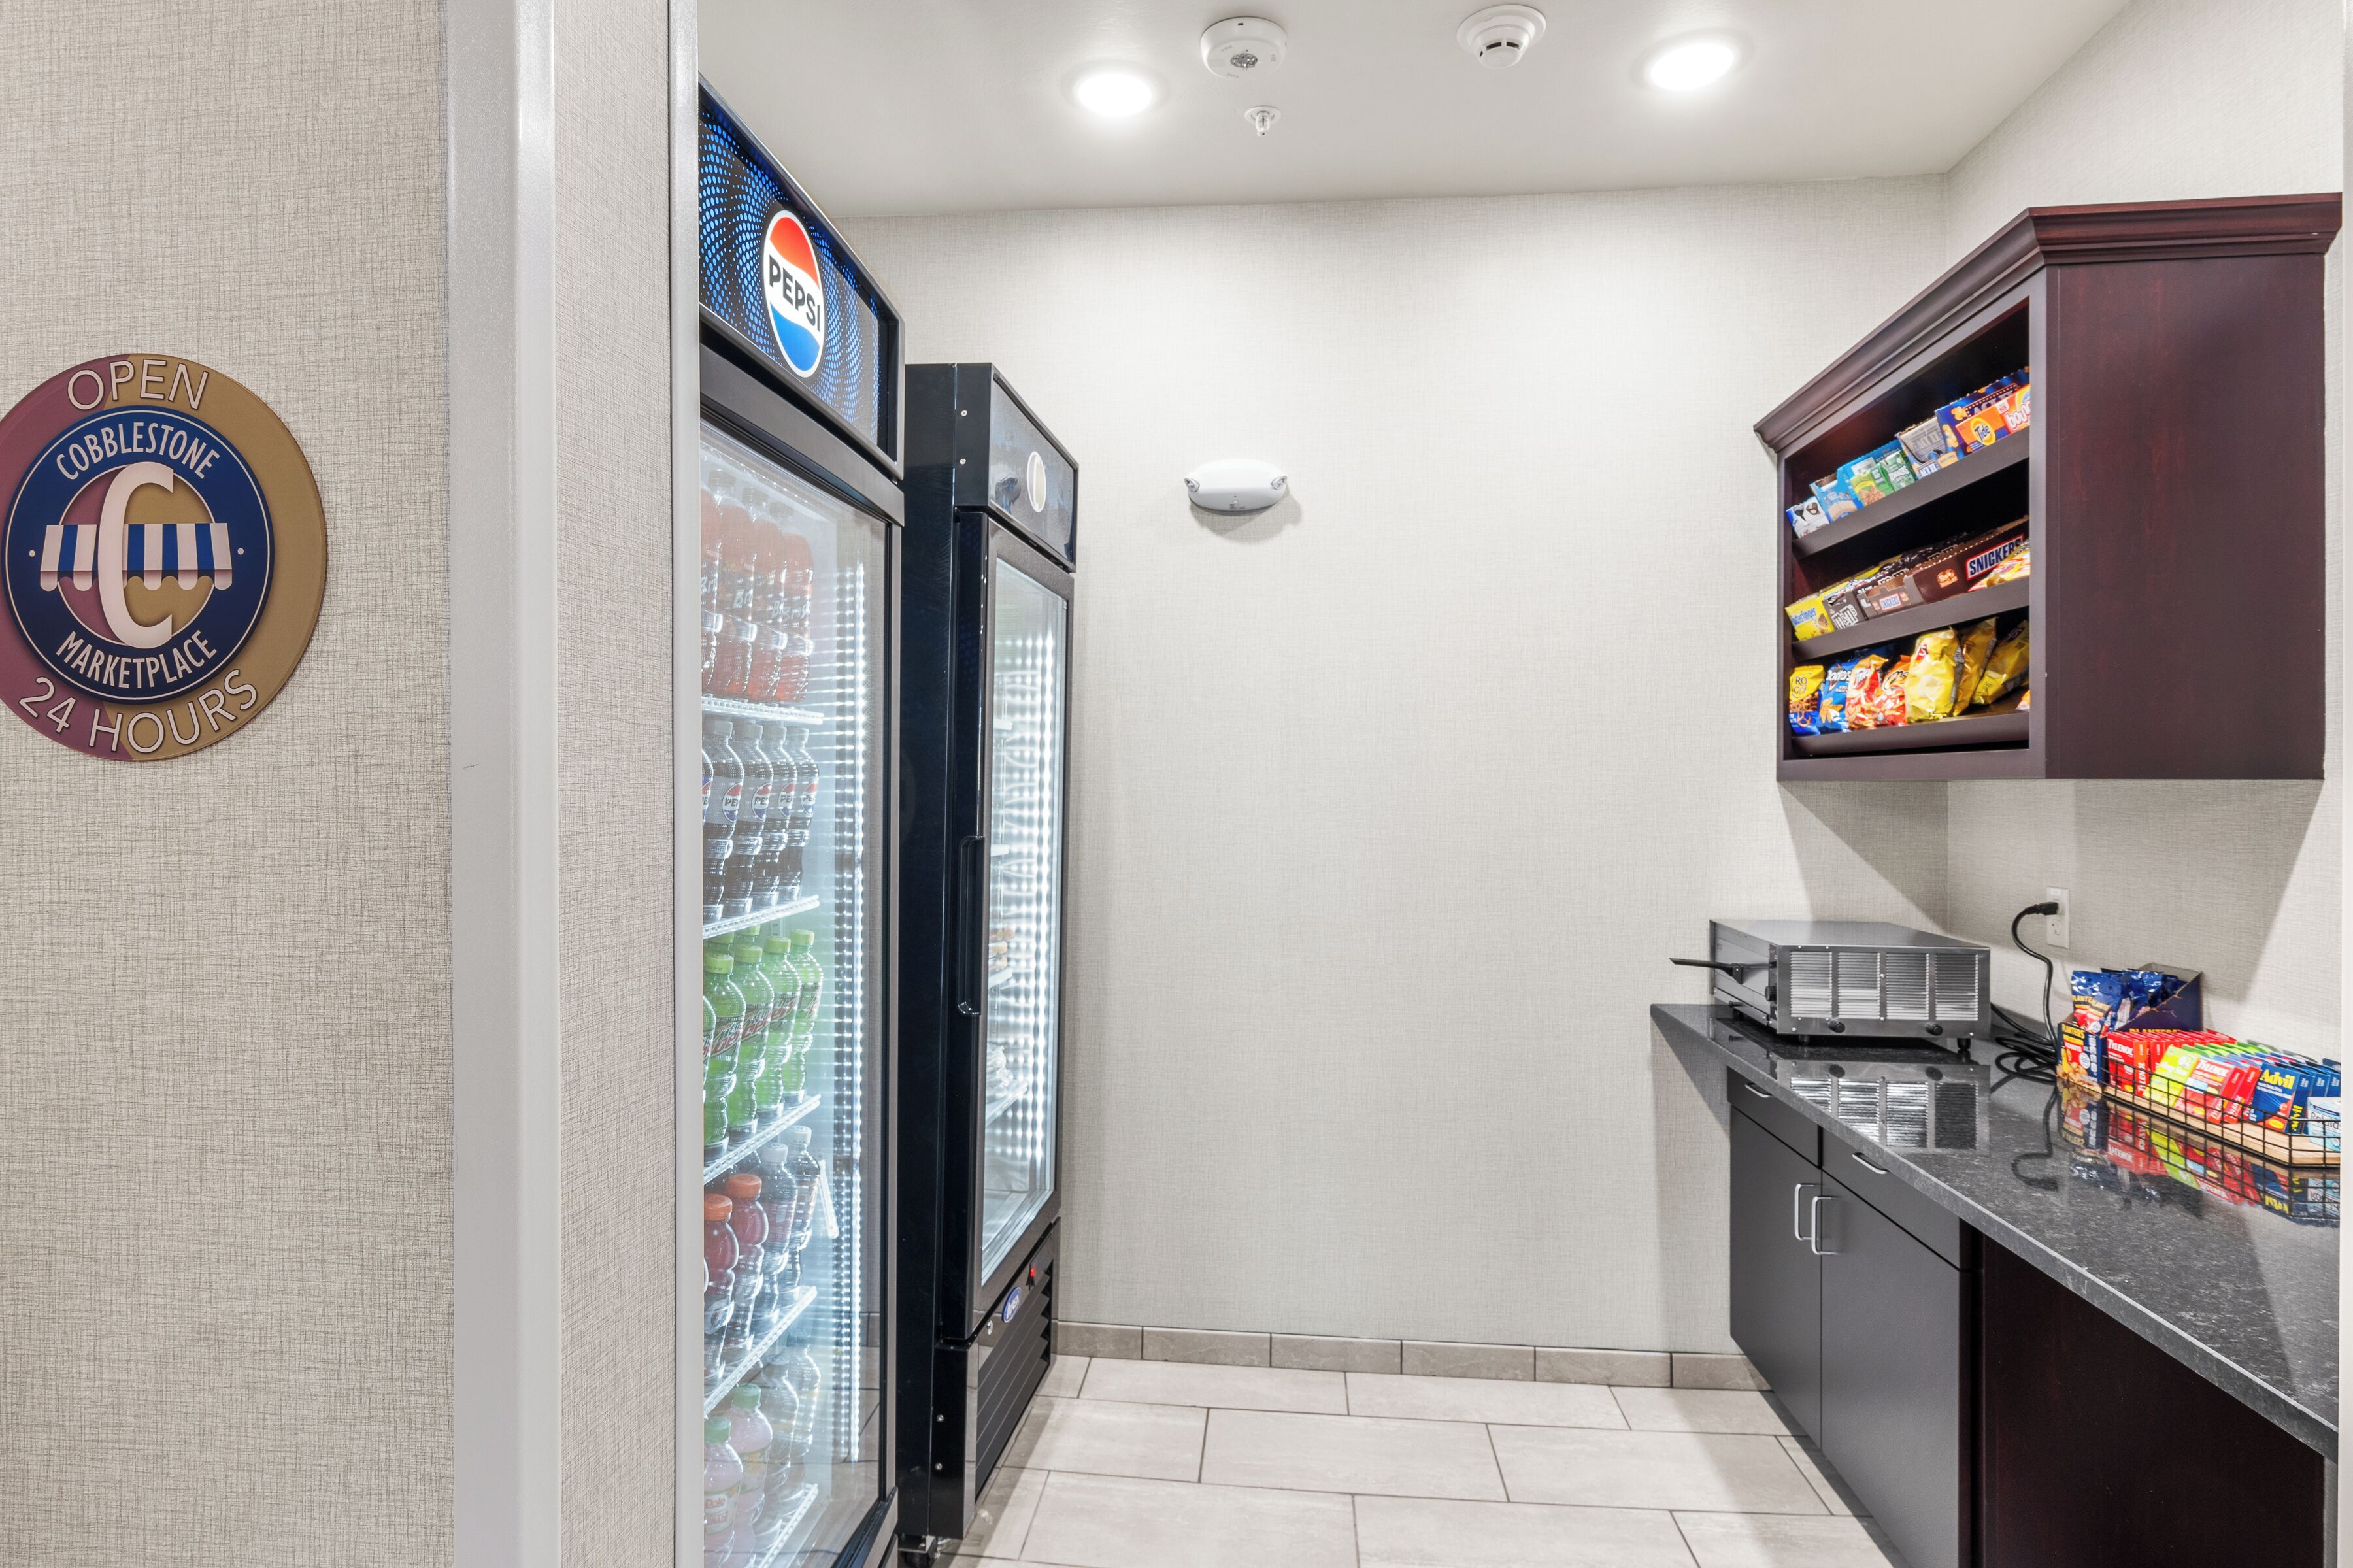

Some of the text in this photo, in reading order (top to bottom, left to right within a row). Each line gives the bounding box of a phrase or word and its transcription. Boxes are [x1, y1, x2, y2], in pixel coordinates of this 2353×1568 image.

[769, 254, 820, 333] PEPSI
[67, 359, 209, 410] OPEN
[56, 421, 220, 480] COBBLESTONE
[1974, 424, 1991, 442] Tide
[97, 461, 175, 649] C
[1969, 537, 2022, 576] SNICKERS
[55, 629, 218, 688] MARKETPLACE
[18, 669, 258, 754] 24 HOURS
[2061, 1024, 2086, 1039] PLANTERS
[2259, 1069, 2295, 1090] Advil
